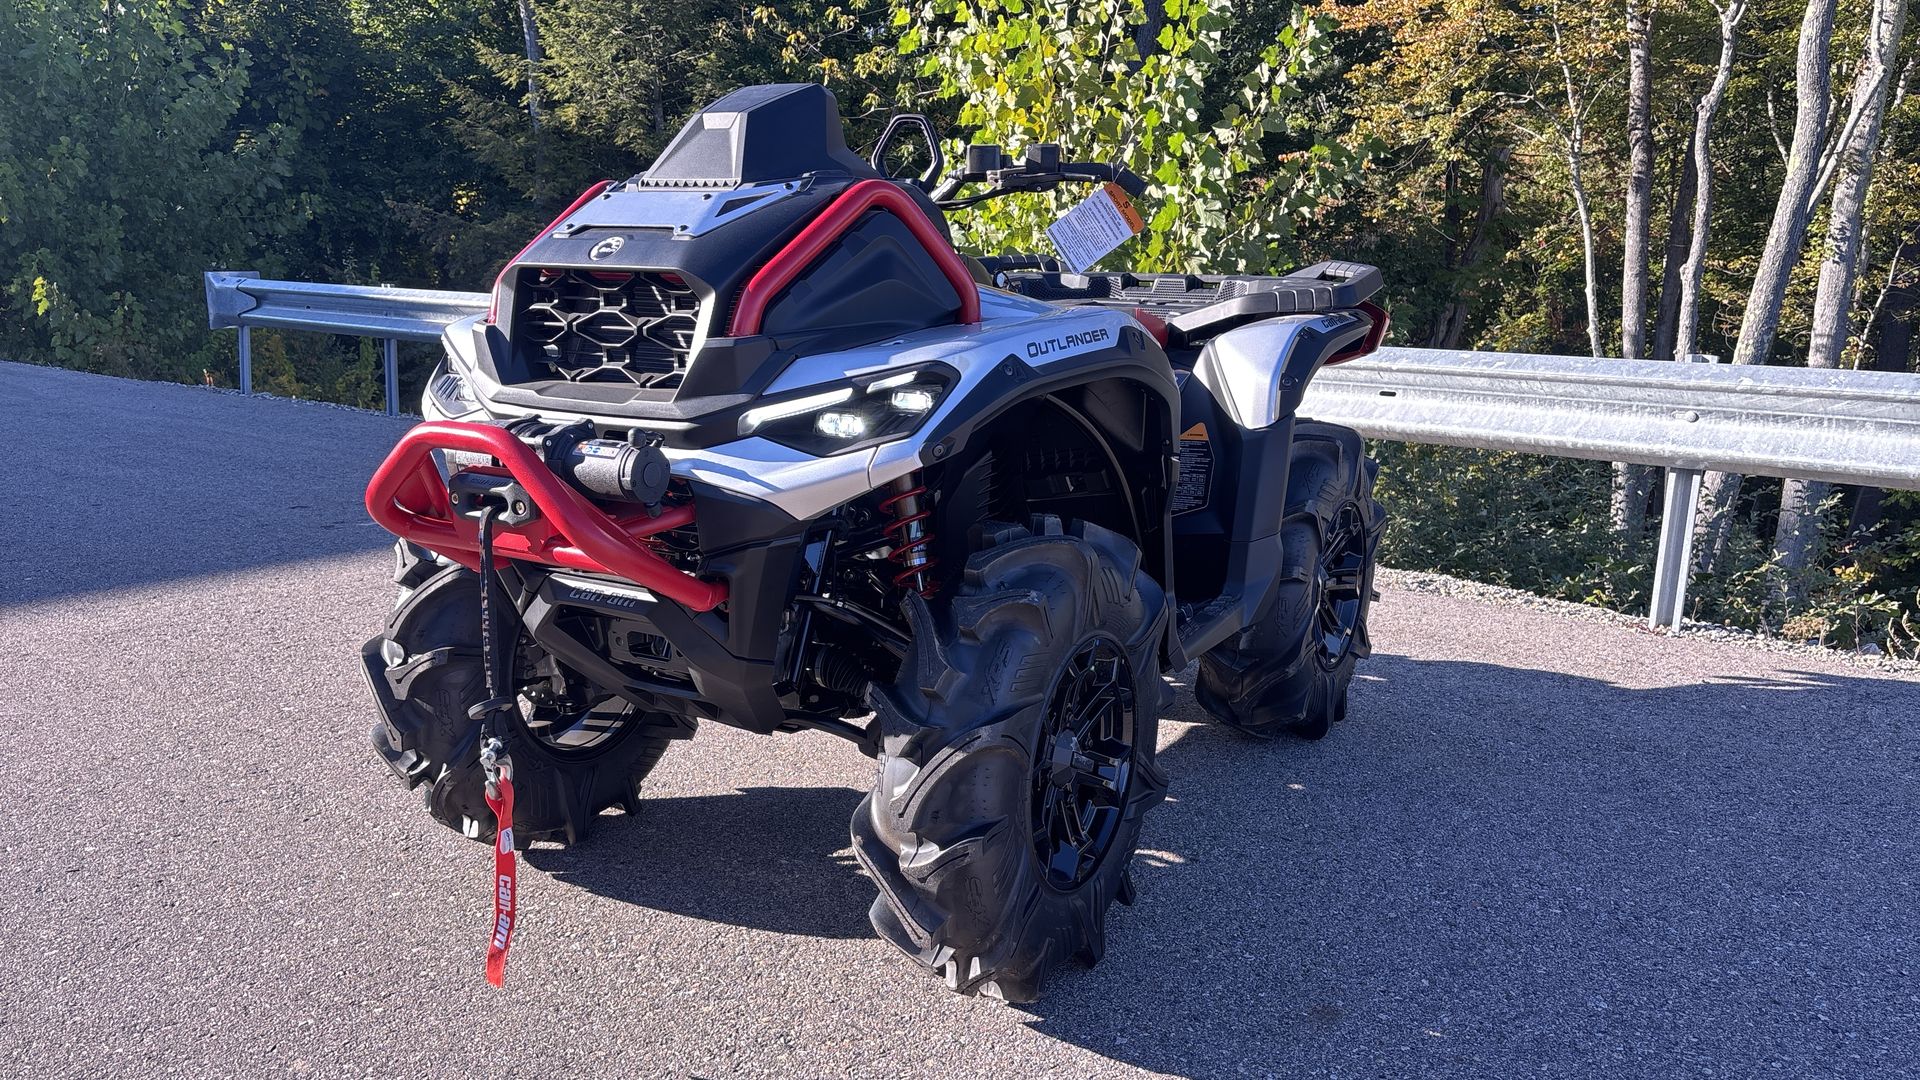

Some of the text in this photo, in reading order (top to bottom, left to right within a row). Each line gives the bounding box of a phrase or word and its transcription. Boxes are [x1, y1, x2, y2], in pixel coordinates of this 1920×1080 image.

[1108, 190, 1135, 229] SPORT MODEL
[1122, 200, 1130, 209] S
[1026, 328, 1110, 358] OUTLANDER
[569, 586, 638, 608] can-am
[494, 874, 512, 950] can-am
